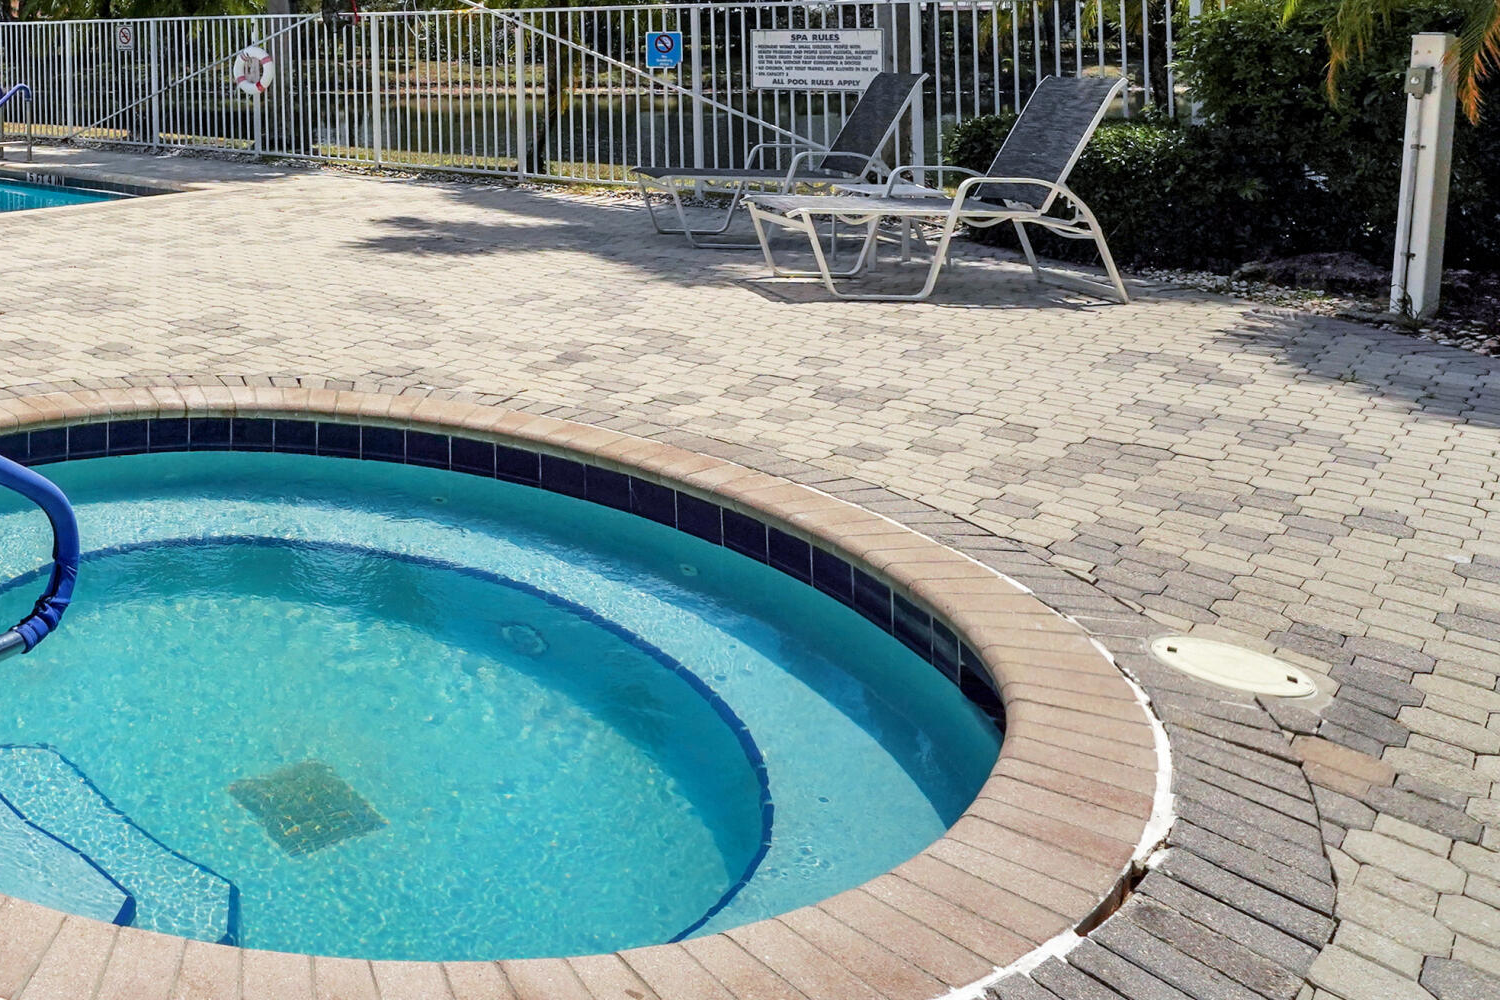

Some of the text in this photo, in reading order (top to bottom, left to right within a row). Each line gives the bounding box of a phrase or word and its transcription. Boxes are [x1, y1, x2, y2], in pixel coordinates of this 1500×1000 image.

[790, 33, 840, 41] SPA RULES
[29, 172, 34, 182] 5
[36, 174, 44, 183] FT
[55, 175, 62, 186] IN
